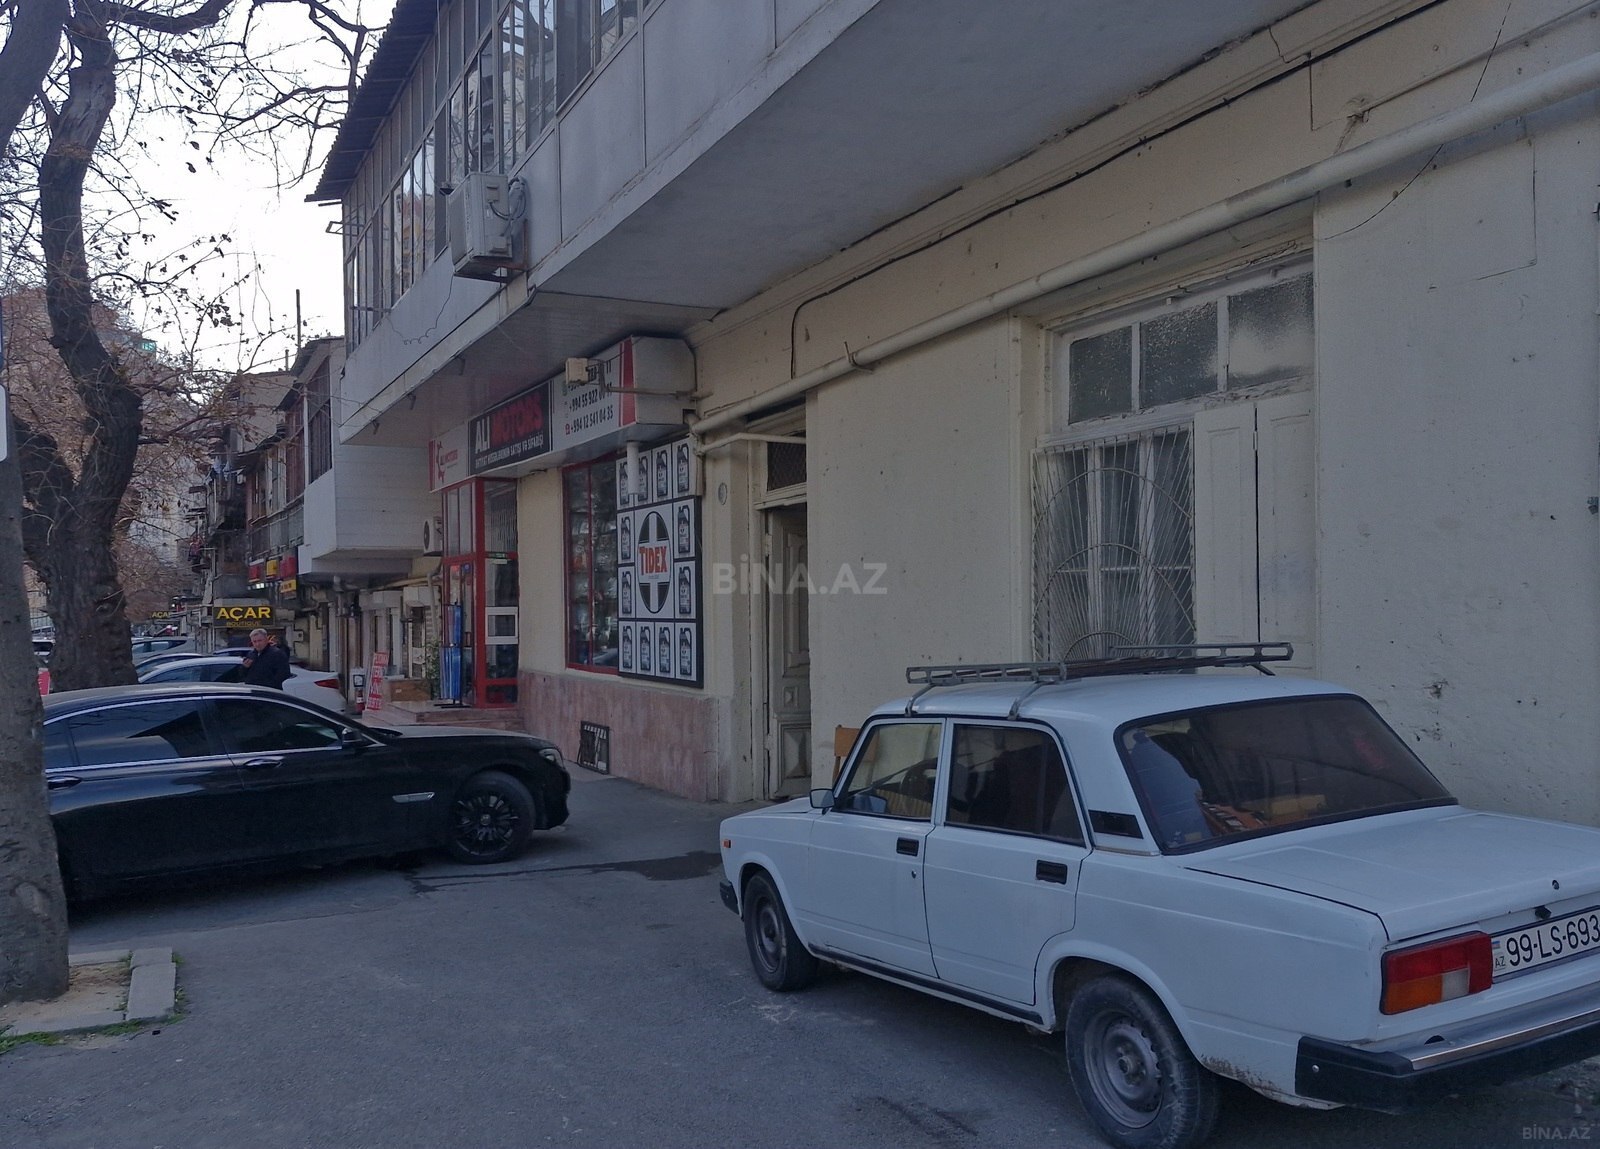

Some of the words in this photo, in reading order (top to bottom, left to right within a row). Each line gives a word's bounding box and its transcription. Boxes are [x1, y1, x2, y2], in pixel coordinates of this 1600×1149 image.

[475, 415, 491, 455] ALI
[491, 391, 544, 448] MOTORS
[571, 416, 583, 433] +994
[583, 414, 589, 429] 12
[589, 410, 598, 427] 541
[599, 407, 606, 423] 04
[639, 546, 668, 576] TIDEX
[216, 606, 271, 621] AÇAR
[1506, 914, 1600, 967] 99-LS-693
[1494, 956, 1506, 968] AZ
